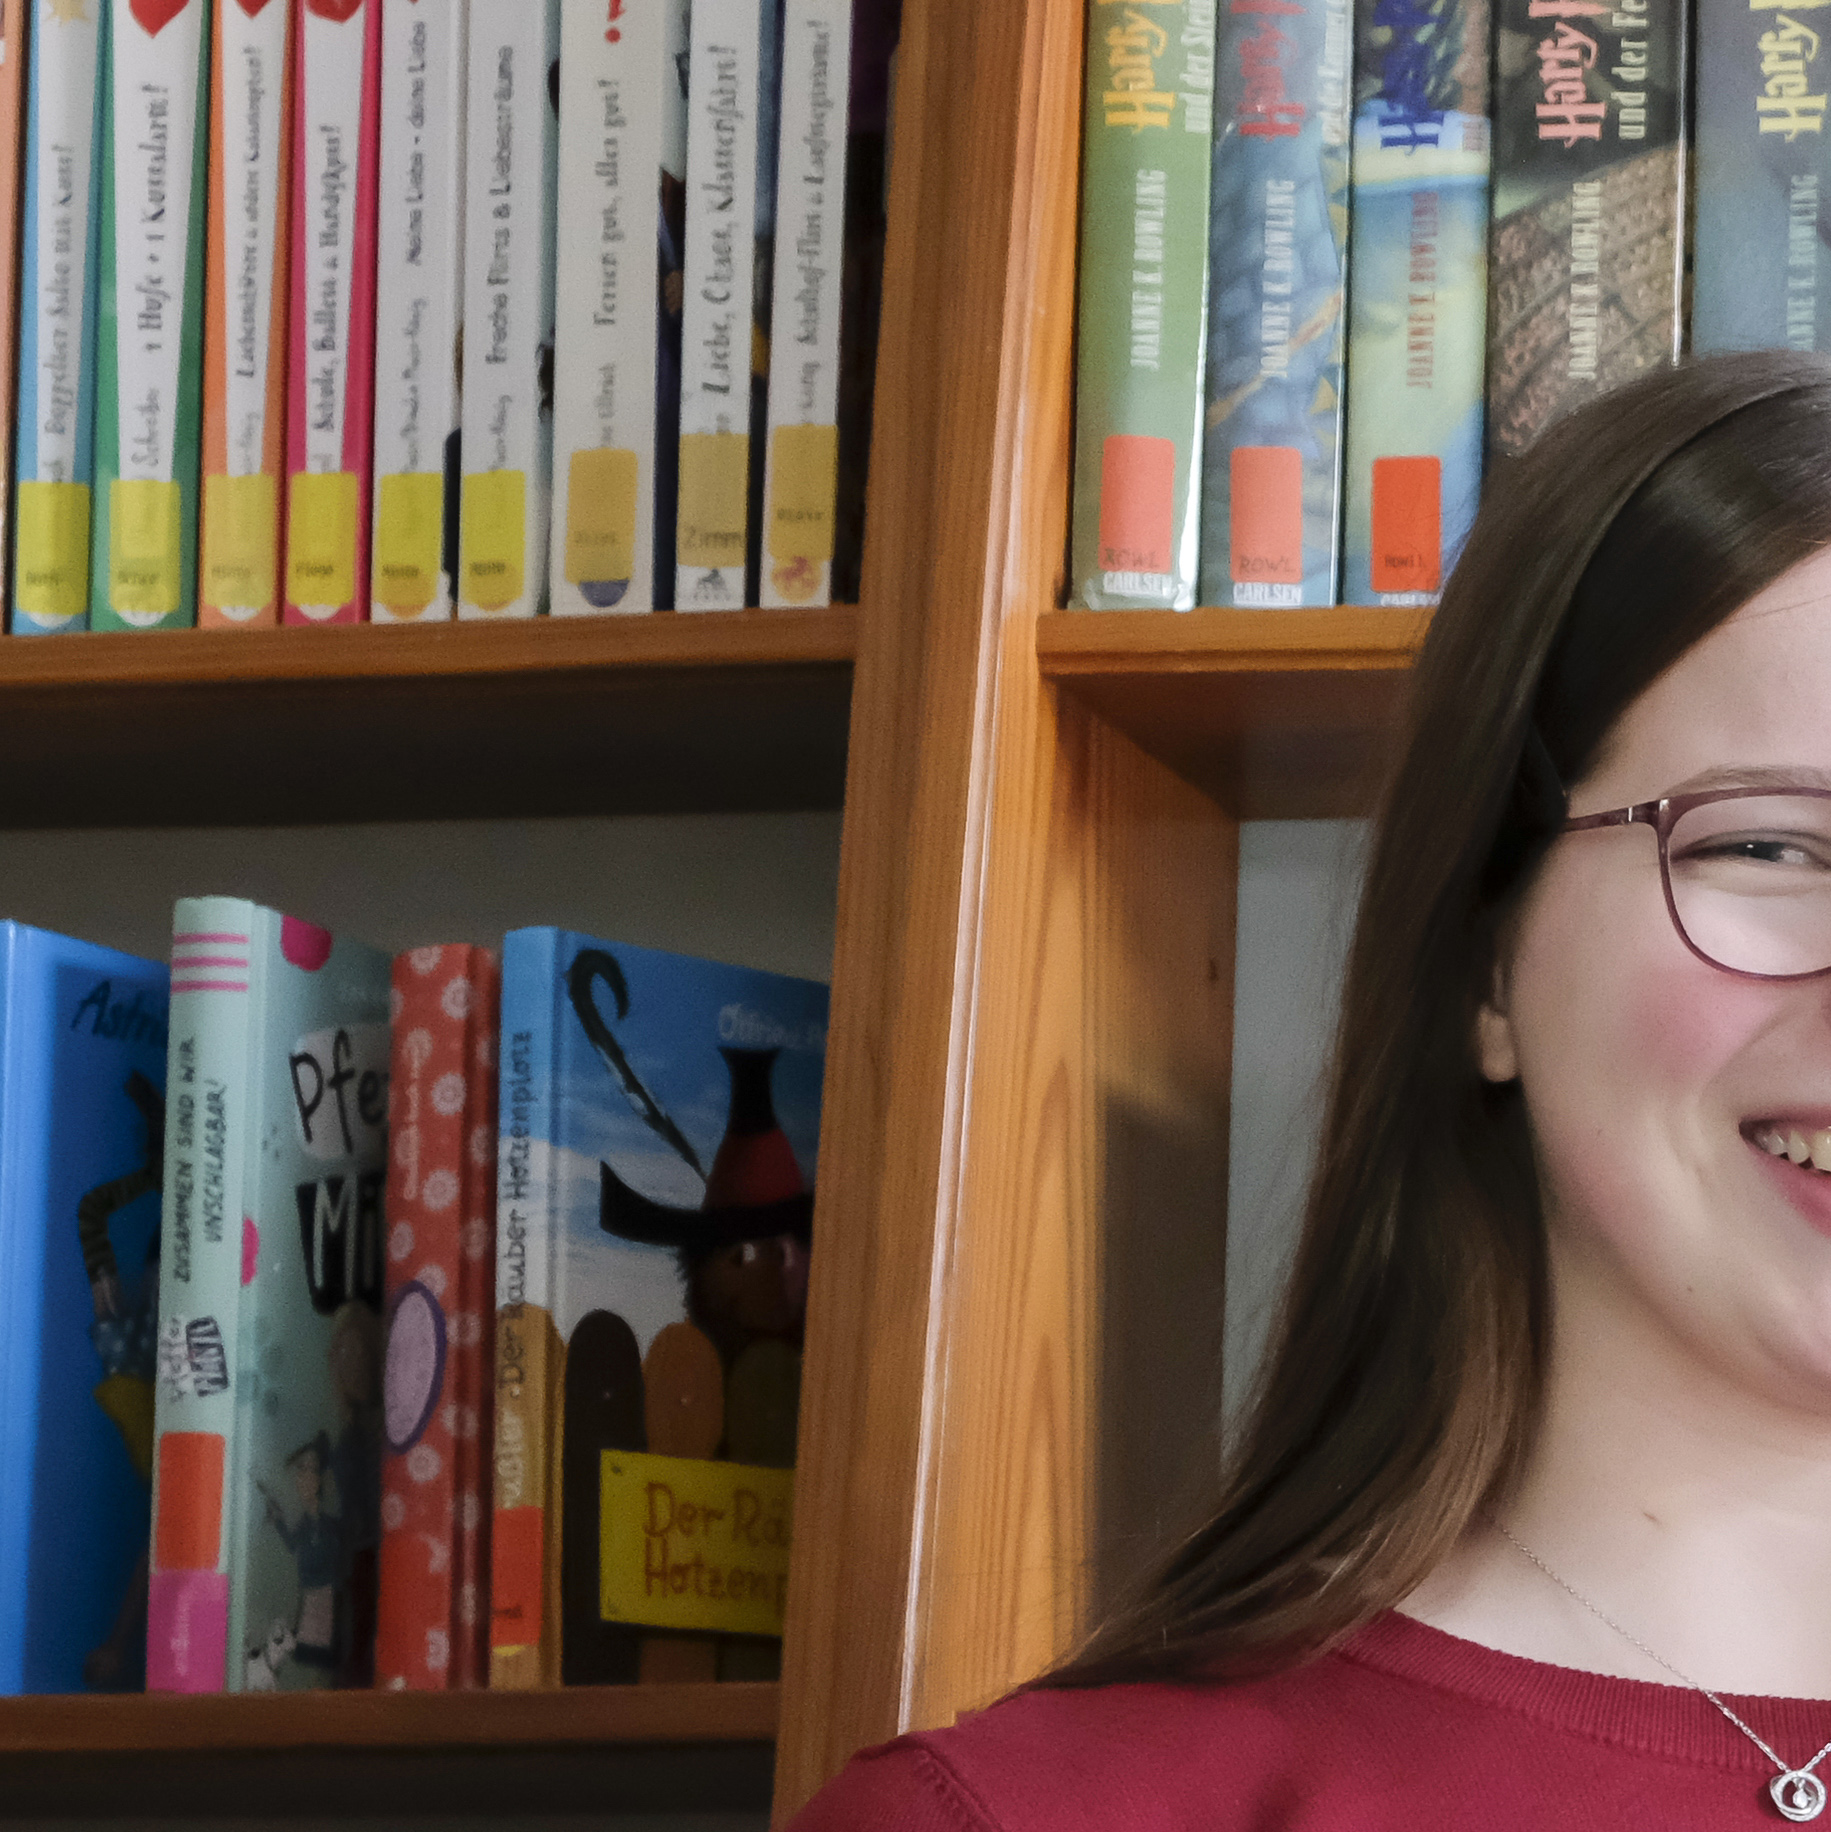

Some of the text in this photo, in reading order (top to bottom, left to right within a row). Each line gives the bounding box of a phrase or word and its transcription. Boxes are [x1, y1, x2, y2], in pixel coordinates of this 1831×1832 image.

[1101, 9, 1176, 134] Harry
[1237, 20, 1305, 141] Harry
[1535, 21, 1606, 148] Harry
[1612, 37, 1647, 140] und der
[1756, 14, 1829, 142] Harry
[1133, 169, 1166, 263] ROWLING
[1130, 292, 1162, 370] JOANNE
[171, 1036, 197, 1285] ZUSAMMEN SIND WIR
[203, 1077, 230, 1244] UNSCHLAGBAR!
